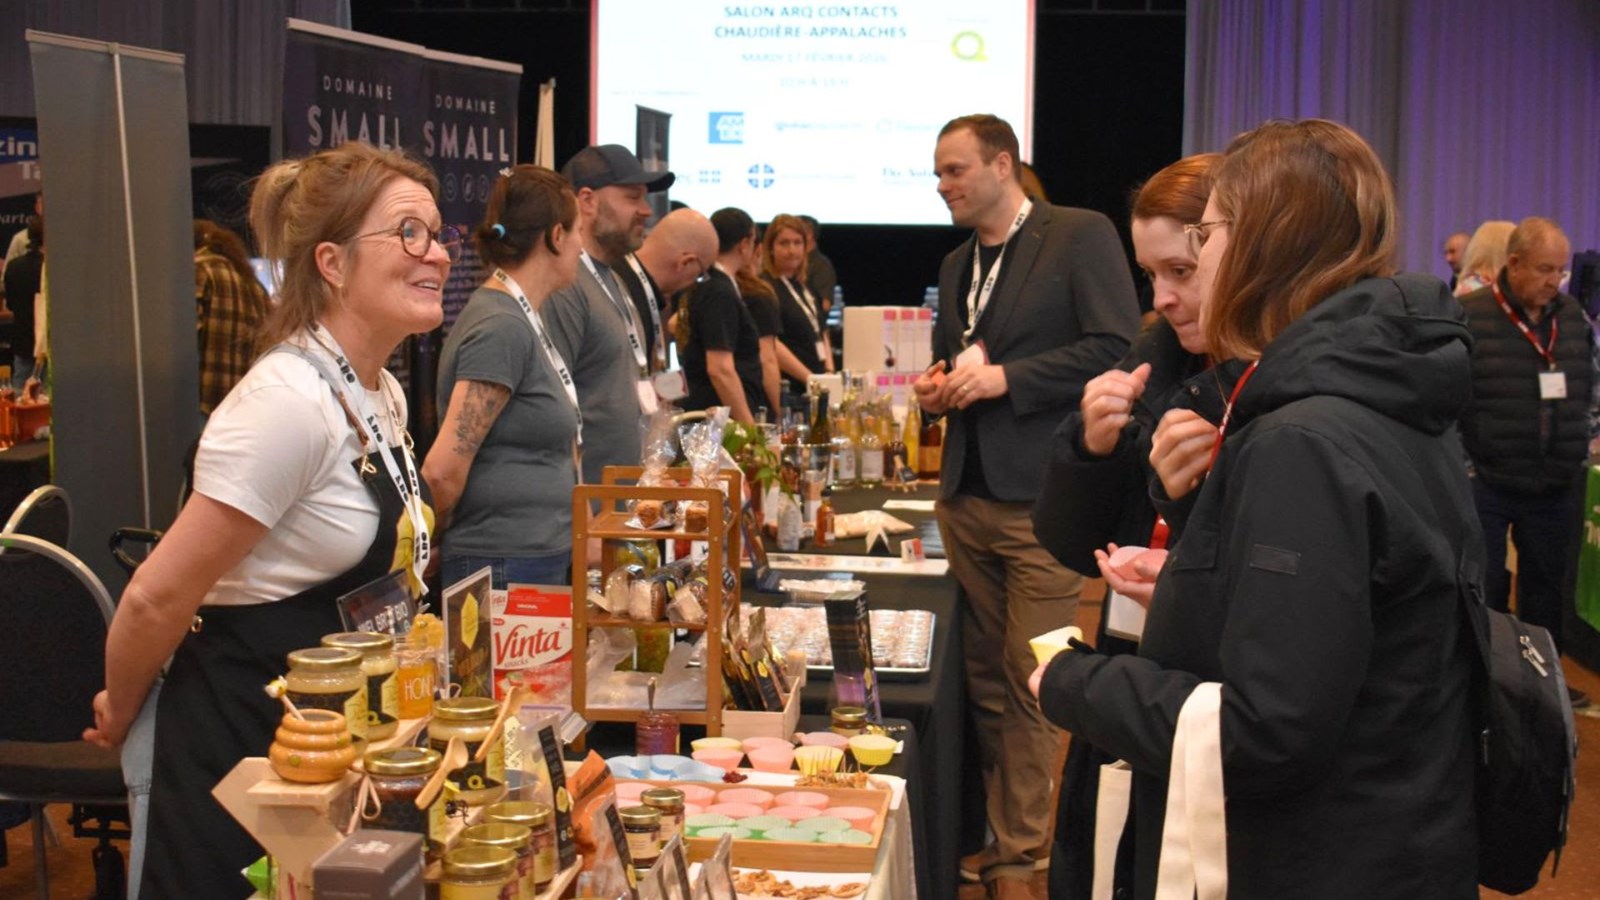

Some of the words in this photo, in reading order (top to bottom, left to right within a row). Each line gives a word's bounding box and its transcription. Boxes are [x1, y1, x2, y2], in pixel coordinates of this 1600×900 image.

[723, 6, 775, 18] SALON
[780, 6, 814, 19] ARQ
[818, 6, 899, 18] CONTACTS
[322, 75, 393, 100] DOMAINE
[434, 93, 497, 115] DOMAINE
[306, 104, 403, 150] SMALL
[422, 120, 510, 162] SMALL
[494, 623, 562, 665] Vinta
